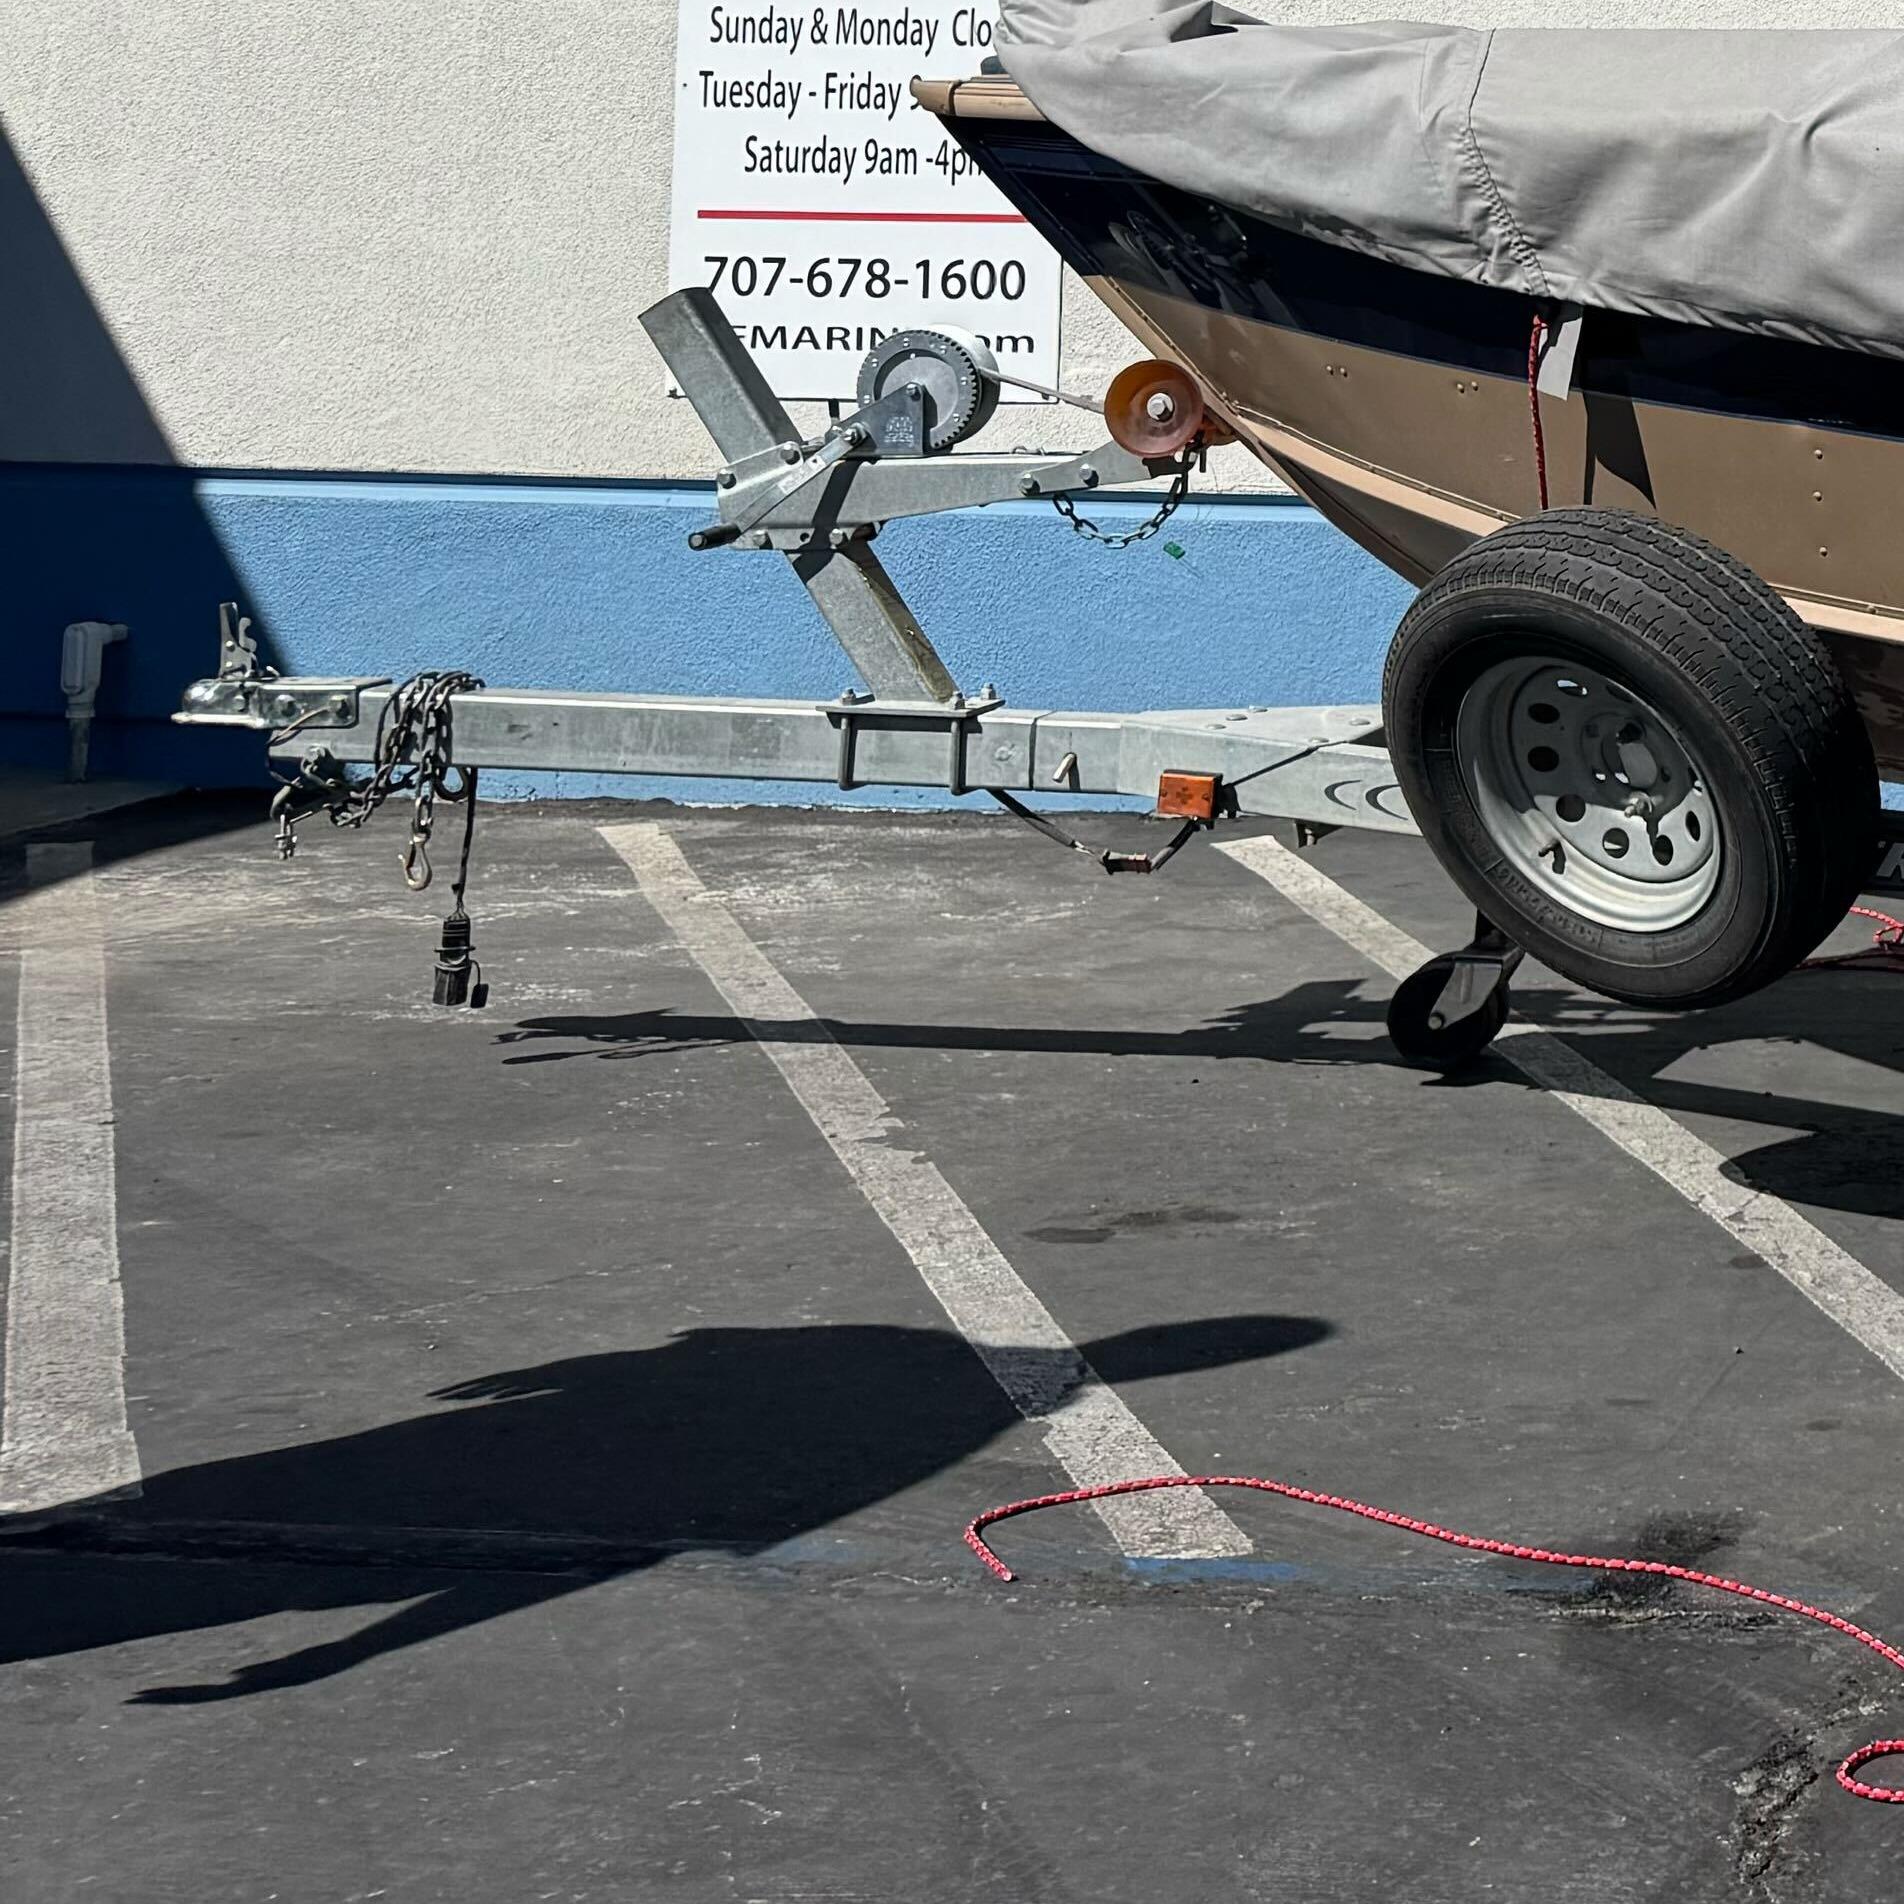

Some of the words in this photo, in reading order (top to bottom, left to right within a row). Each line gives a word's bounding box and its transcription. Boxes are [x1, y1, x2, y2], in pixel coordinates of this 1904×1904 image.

[710, 5, 803, 55] Sunday
[810, 8, 828, 45] &
[836, 6, 939, 57] Monday
[952, 8, 992, 47] Clo
[699, 69, 802, 120] Tuesday
[824, 71, 902, 121] Friday
[744, 134, 857, 184] Saturday
[864, 138, 917, 176] 9am
[704, 256, 1026, 300] 707-678-1600
